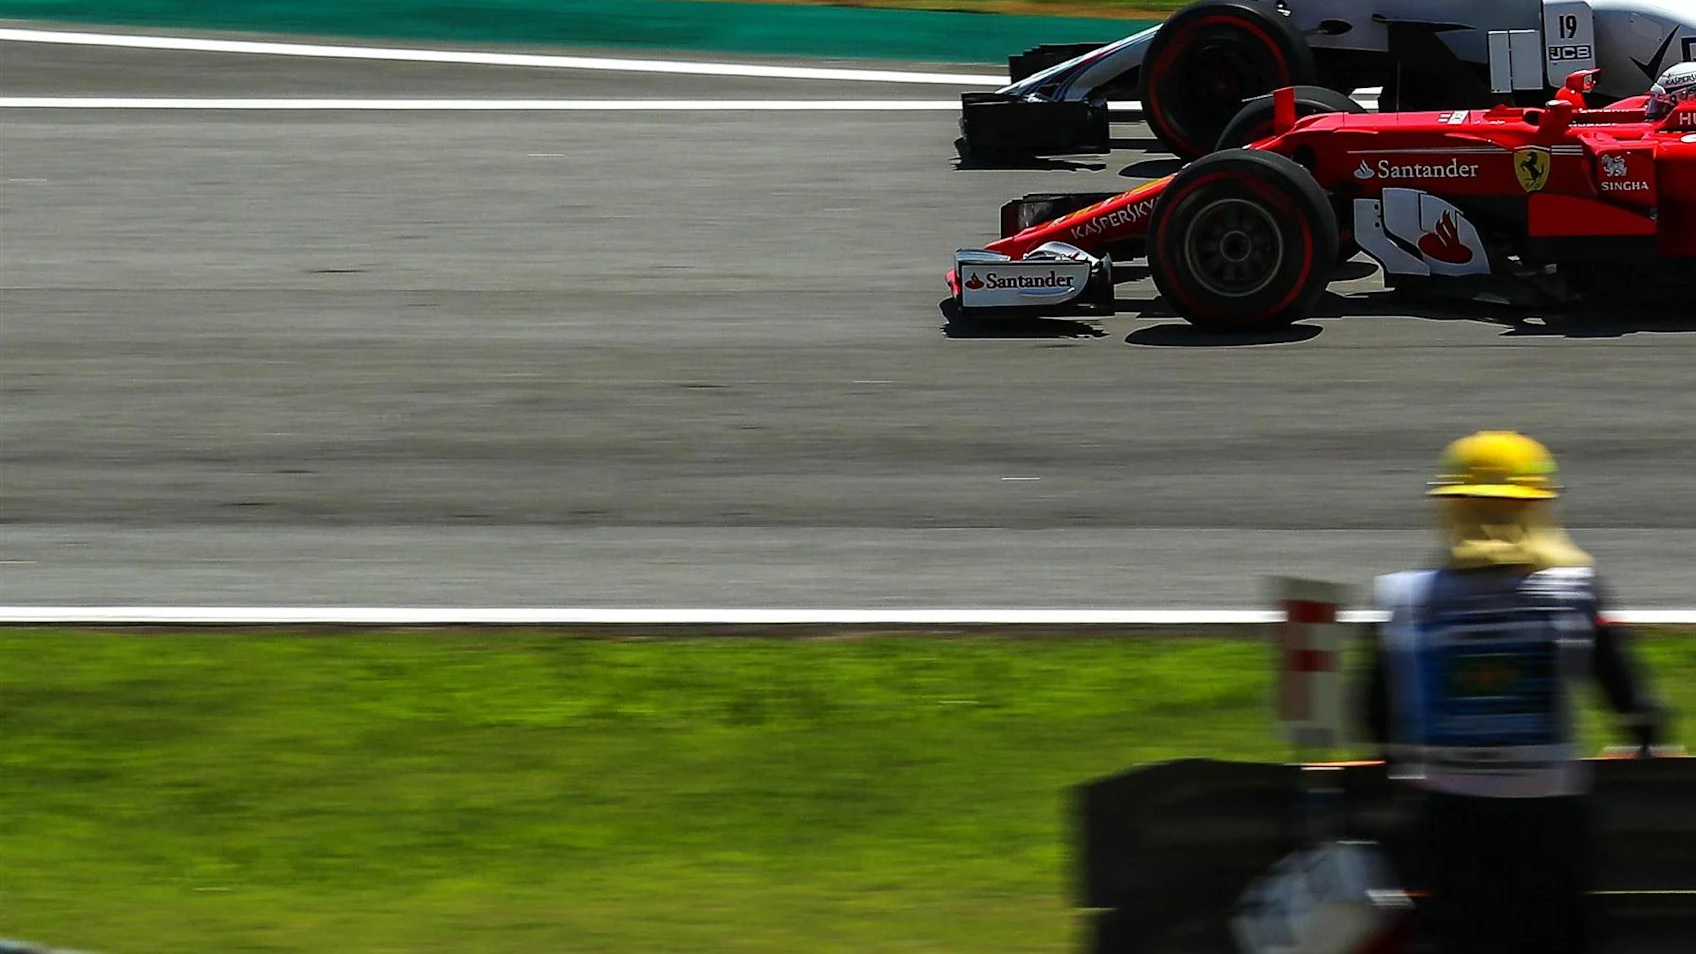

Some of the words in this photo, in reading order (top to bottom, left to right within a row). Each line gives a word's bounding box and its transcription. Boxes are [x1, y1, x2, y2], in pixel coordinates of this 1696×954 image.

[1558, 15, 1578, 39] 19
[1550, 46, 1591, 59] JCB
[1378, 158, 1479, 178] Santander
[1601, 181, 1649, 191] SINGHA
[1071, 198, 1157, 240] KASPERSKY
[986, 271, 1074, 289] Santander
